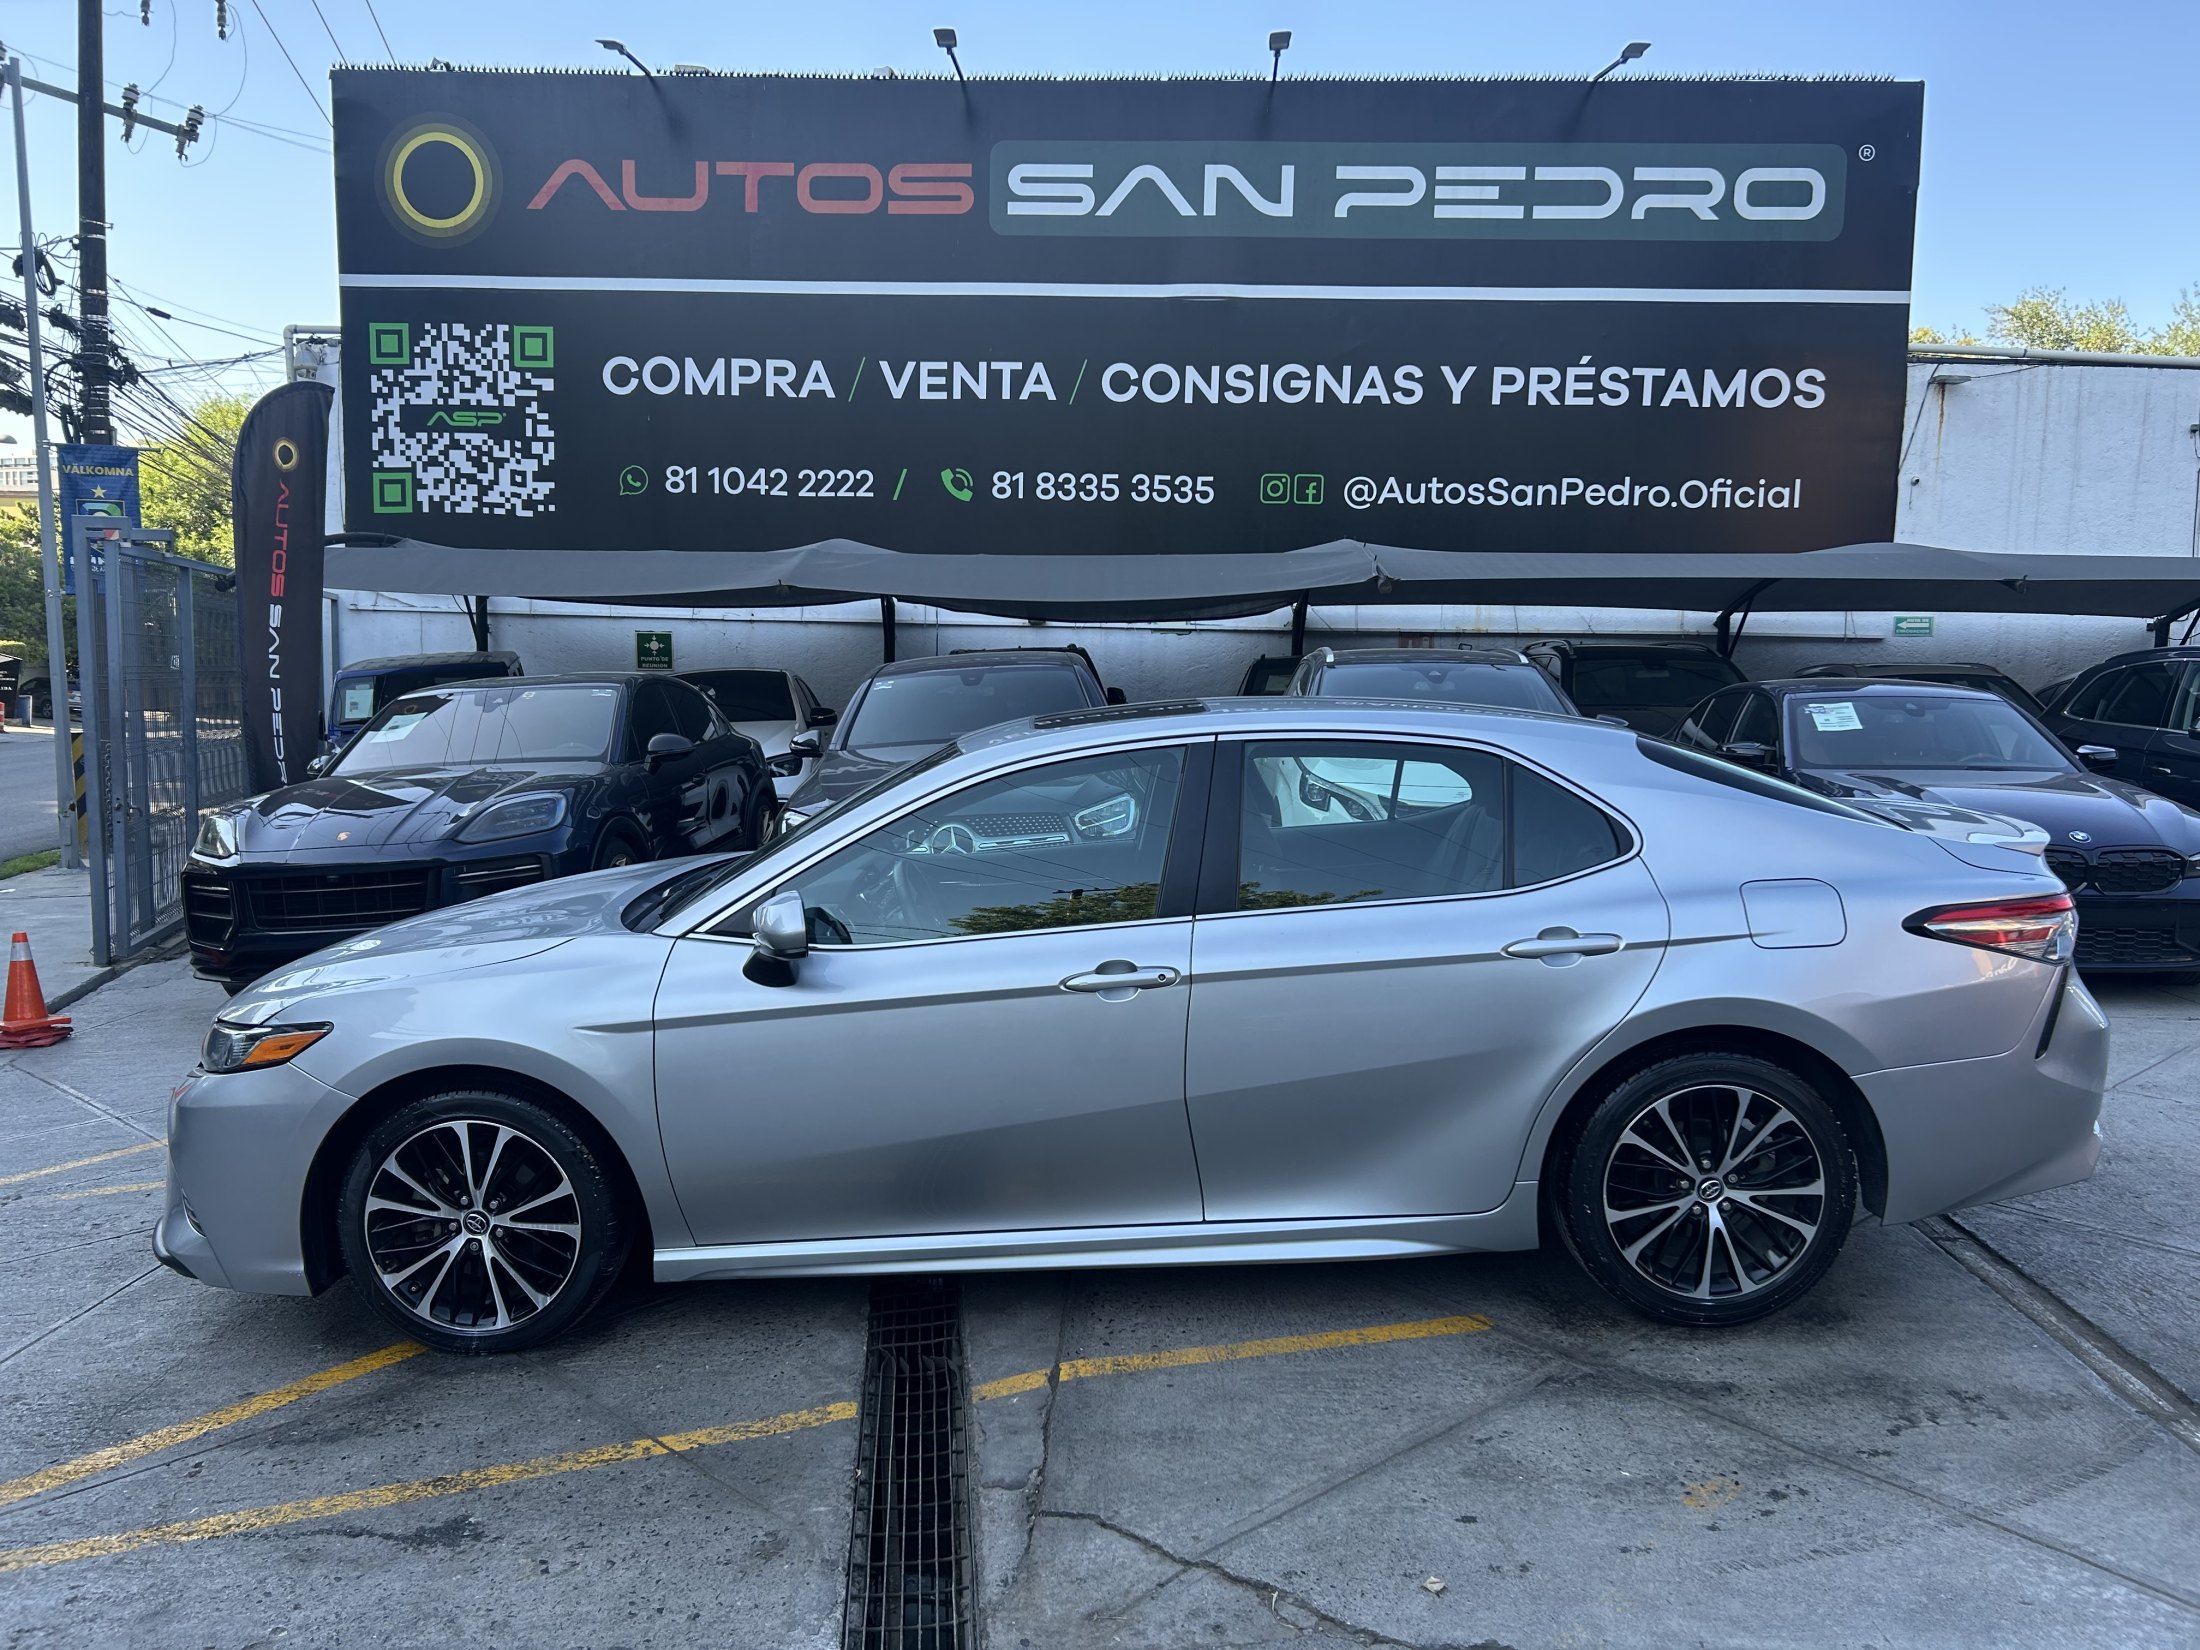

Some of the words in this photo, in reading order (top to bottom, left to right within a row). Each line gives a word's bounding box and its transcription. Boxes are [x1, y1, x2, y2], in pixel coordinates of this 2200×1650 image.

[527, 159, 974, 214] AUTOS
[1007, 164, 1295, 217] SAN
[1334, 166, 1827, 221] PEDRO
[602, 355, 837, 398] COMPRA
[879, 360, 1057, 400] VENTA
[1101, 362, 1424, 406] CONSIGNAS
[1440, 366, 1477, 405] Y
[1491, 355, 1827, 409] PRÉSTAMOS
[664, 465, 696, 494] 81
[707, 466, 788, 497] 1042
[797, 468, 875, 498] 2222
[991, 470, 1024, 500] 81
[1035, 472, 1120, 502] 8335
[1130, 473, 1215, 505] 3535
[1343, 474, 1803, 510] @AutosSanPedro.Oficial
[270, 479, 290, 597] AUTOS
[268, 603, 283, 680] SAN
[270, 687, 289, 788] PEDR
